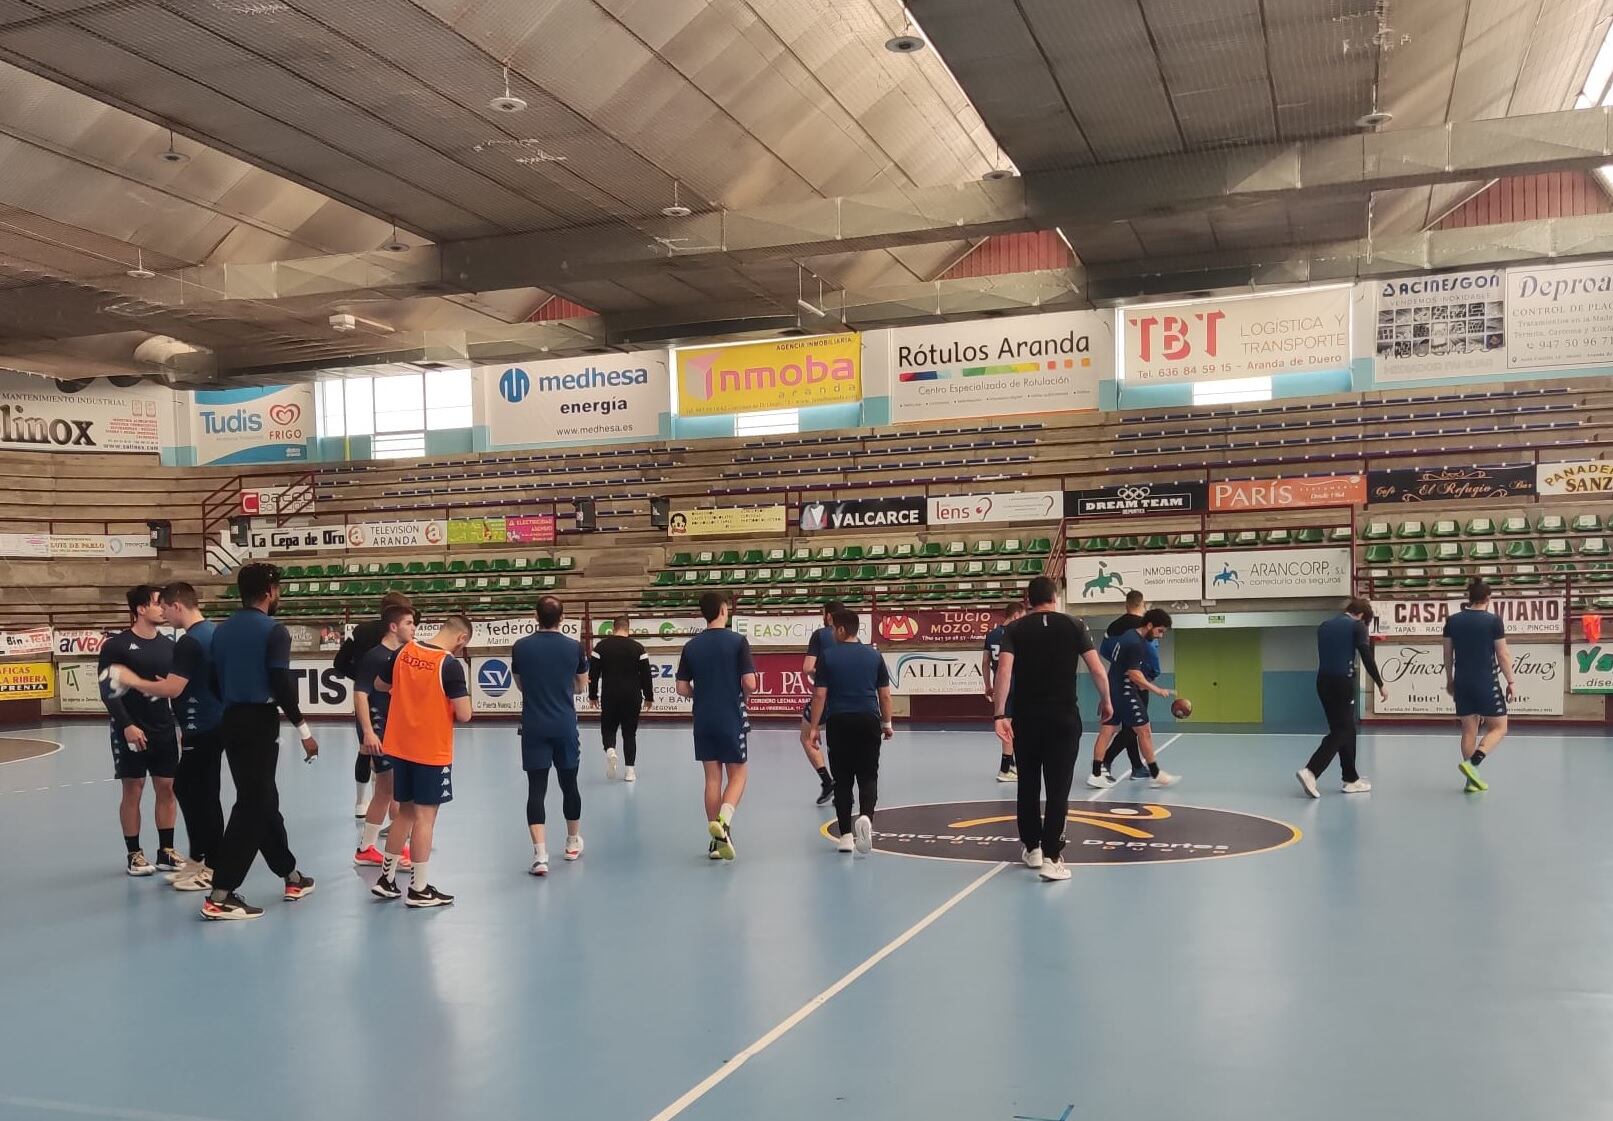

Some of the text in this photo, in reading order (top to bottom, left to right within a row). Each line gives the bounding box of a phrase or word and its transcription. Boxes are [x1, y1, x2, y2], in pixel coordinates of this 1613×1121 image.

[1512, 304, 1564, 316] CONTROL
[1570, 303, 1585, 312] DE
[1334, 313, 1345, 326] Y
[1128, 309, 1226, 362] TBT
[776, 337, 852, 351] AGENCIA INMOBILIARIA
[897, 330, 1090, 368] Rótulos Aranda
[1241, 333, 1346, 356] TRANSPORTE
[1539, 340, 1560, 349] 947
[1565, 338, 1579, 348] 50
[1583, 337, 1597, 346] 96
[1158, 367, 1179, 377] 636
[1183, 366, 1197, 375] 84
[1202, 364, 1216, 374] 59
[1221, 363, 1232, 372] 15
[1247, 358, 1285, 370] Aranda
[1289, 357, 1303, 366] de
[1308, 354, 1342, 365] Duero
[539, 366, 648, 392] medhesa
[918, 376, 1069, 395] Centro Especializado de Rotulación
[778, 383, 856, 399] aranda
[2, 393, 127, 407] MANTENIMIENTO INDUSTRIAL
[560, 396, 628, 415] energía
[199, 409, 263, 434] Tudis
[269, 429, 302, 440] FRIGO
[556, 422, 633, 437] www.medhesa.es
[1215, 480, 1293, 507] PARÍS
[936, 500, 970, 520] lens
[1085, 497, 1183, 511] DREAM TEAM
[832, 508, 920, 528] VALCARCE
[370, 524, 419, 535] TELEVISIÓN
[251, 533, 266, 548] La
[305, 531, 318, 546] de
[372, 535, 418, 546] ARANDA
[1142, 564, 1200, 577] INMOBICORP
[1294, 577, 1306, 585] de
[944, 612, 991, 623] LUCIO
[1395, 602, 1450, 623] CASA
[931, 623, 975, 634] MOZO,
[1380, 647, 1446, 683] Finca
[13, 675, 47, 684] RIBERA
[1408, 694, 1440, 703] Hotel
[1083, 839, 1229, 850] Deportes
